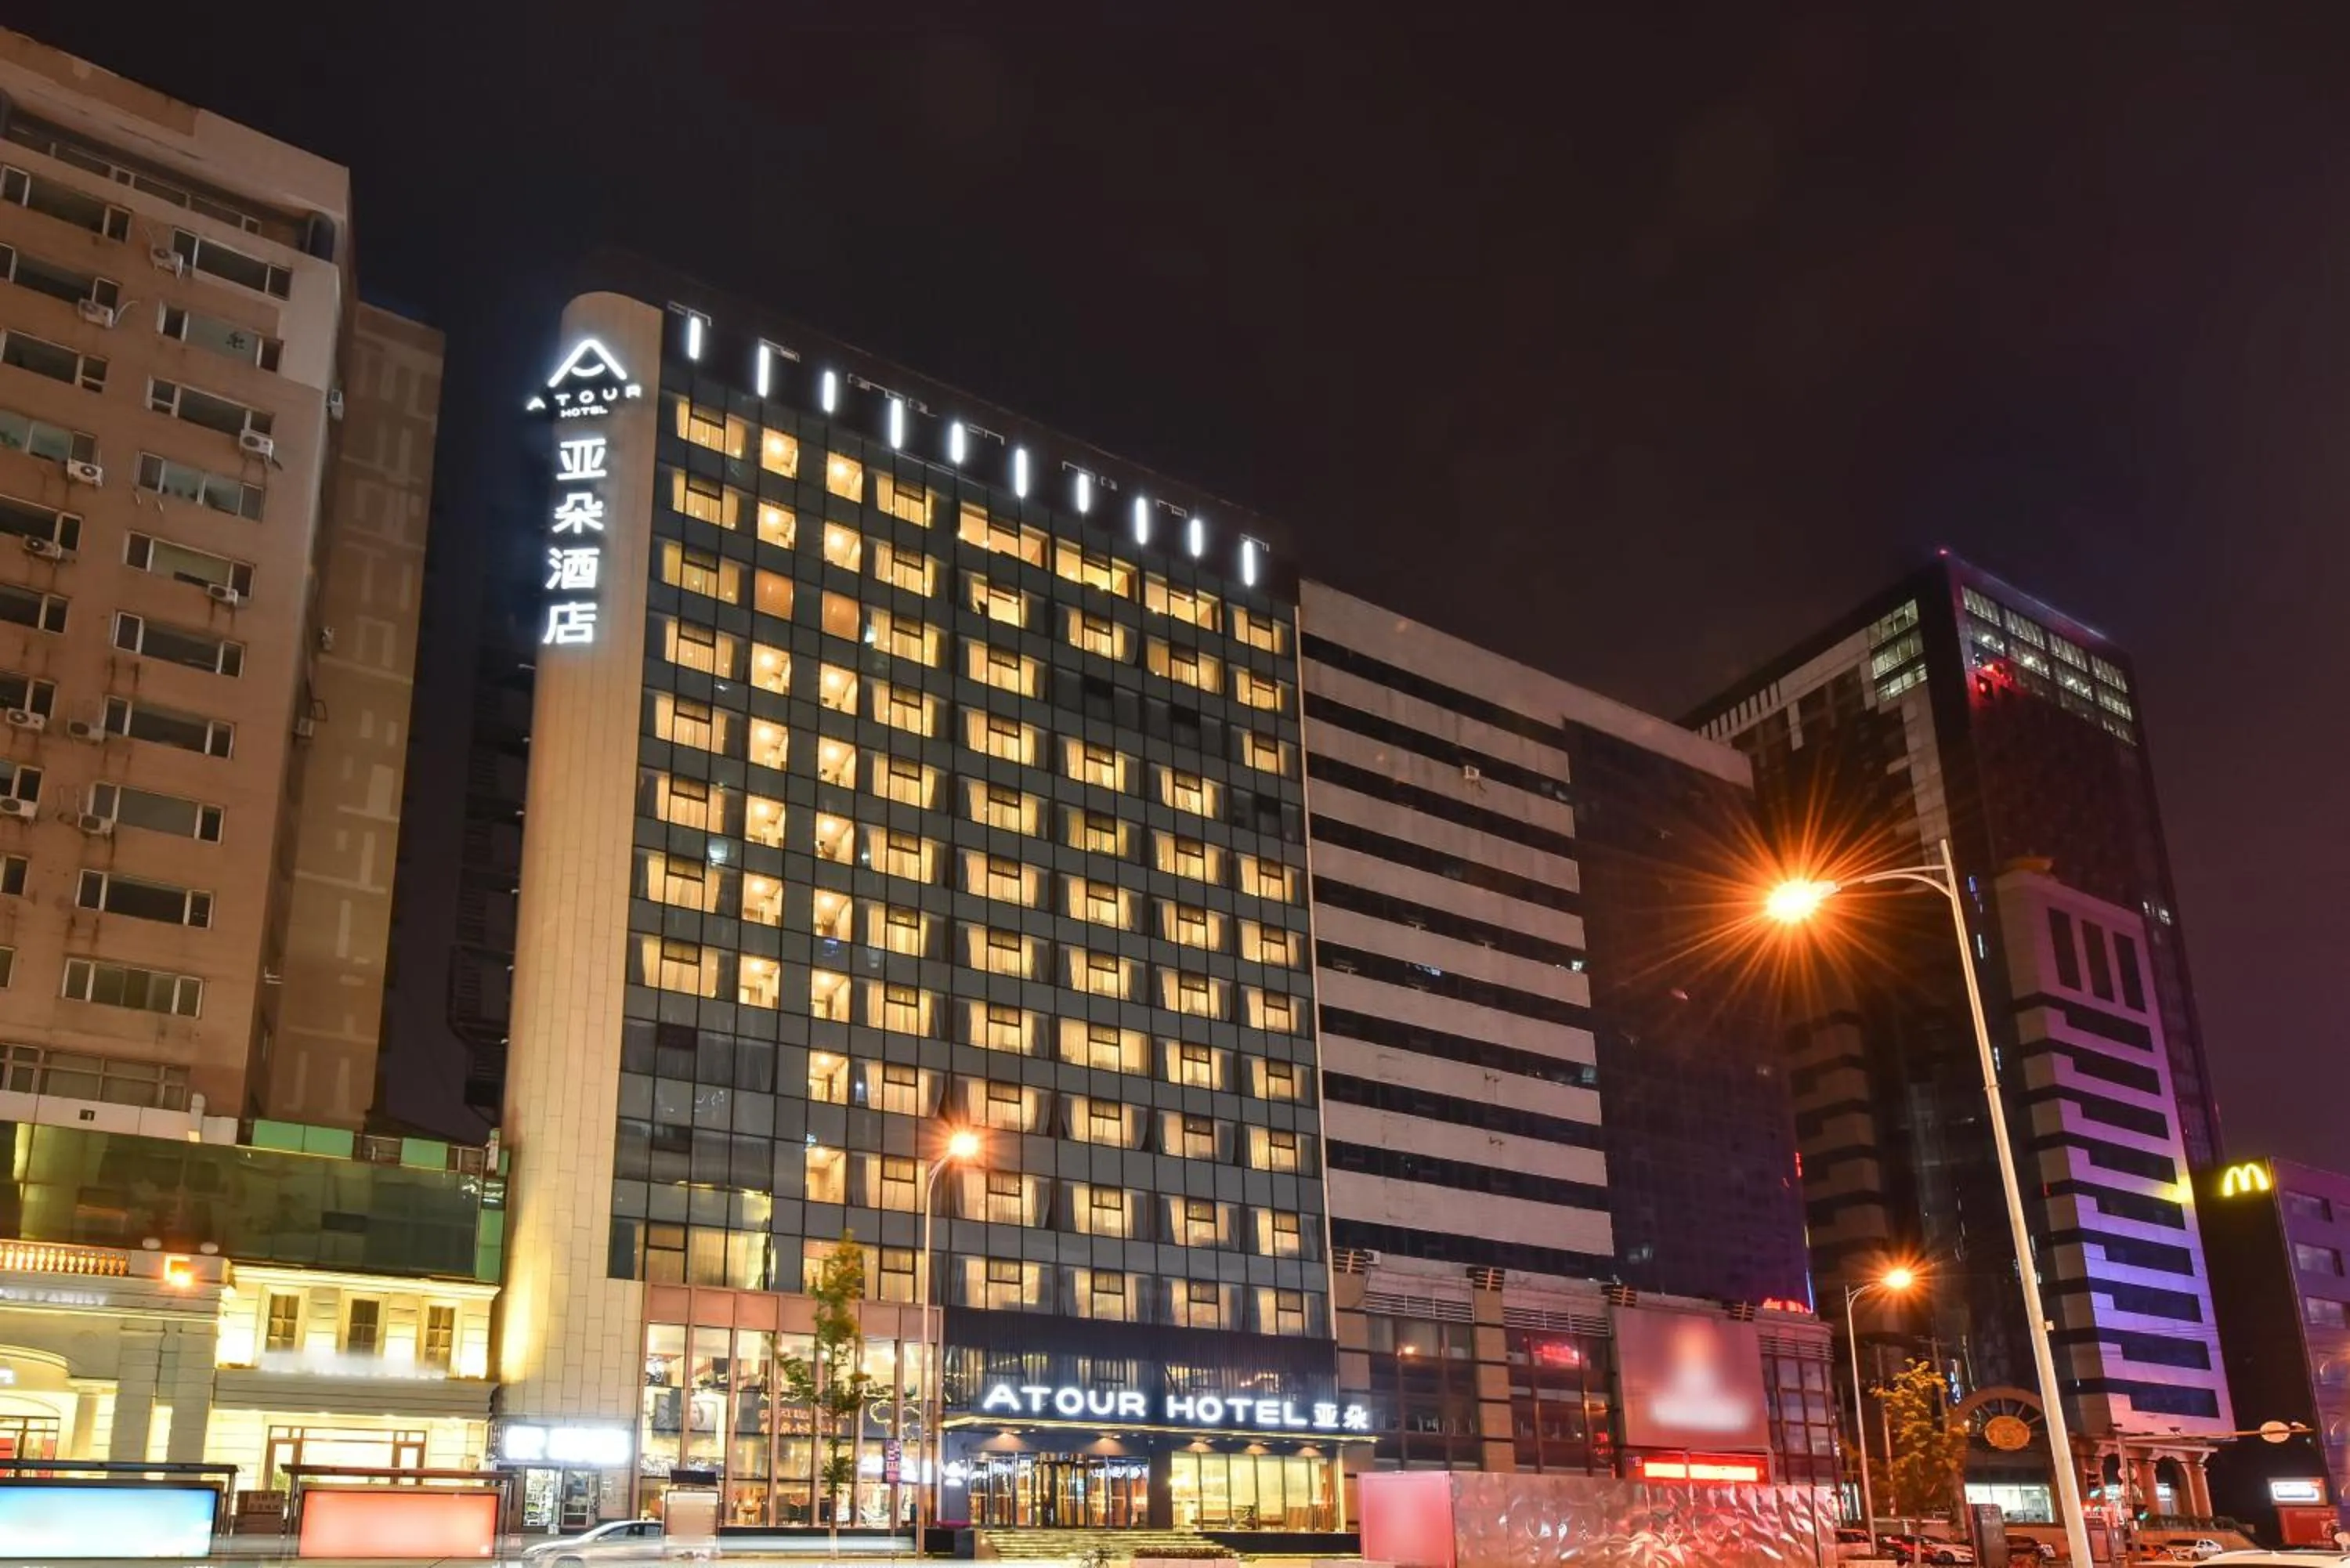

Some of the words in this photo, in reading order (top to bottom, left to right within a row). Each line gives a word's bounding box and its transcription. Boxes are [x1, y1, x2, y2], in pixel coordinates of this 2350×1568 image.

[526, 385, 642, 410] ATOUR
[560, 406, 608, 417] HOTEL
[543, 438, 607, 645] 亚朵酒店
[983, 1384, 1146, 1417] ATOUR
[1166, 1396, 1308, 1425] HOTEL
[1313, 1403, 1368, 1429] 亚朵
